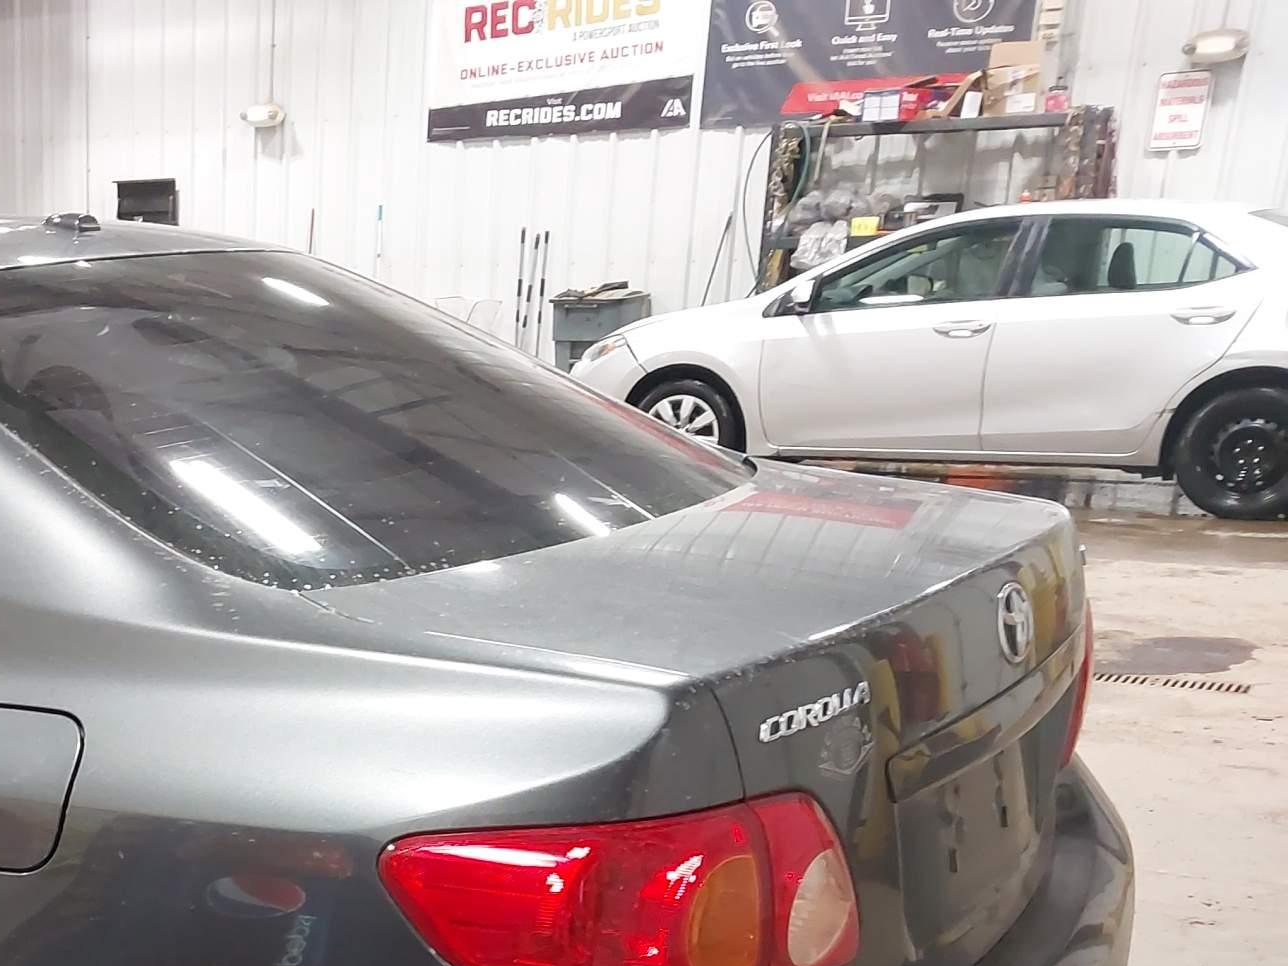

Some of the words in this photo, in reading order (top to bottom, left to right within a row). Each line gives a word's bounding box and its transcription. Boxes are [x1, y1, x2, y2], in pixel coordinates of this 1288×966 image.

[464, 0, 536, 43] REC
[927, 27, 973, 38] Real-Time
[975, 25, 1015, 36] Updates
[831, 35, 857, 45] Quick
[858, 34, 876, 43] and
[877, 32, 898, 42] Easy
[460, 51, 596, 81] ONLINE-EXCLUSIVE
[600, 41, 663, 60] AUCTION
[485, 101, 622, 127] RECRIDES.COM
[758, 681, 872, 743] COROLLA
